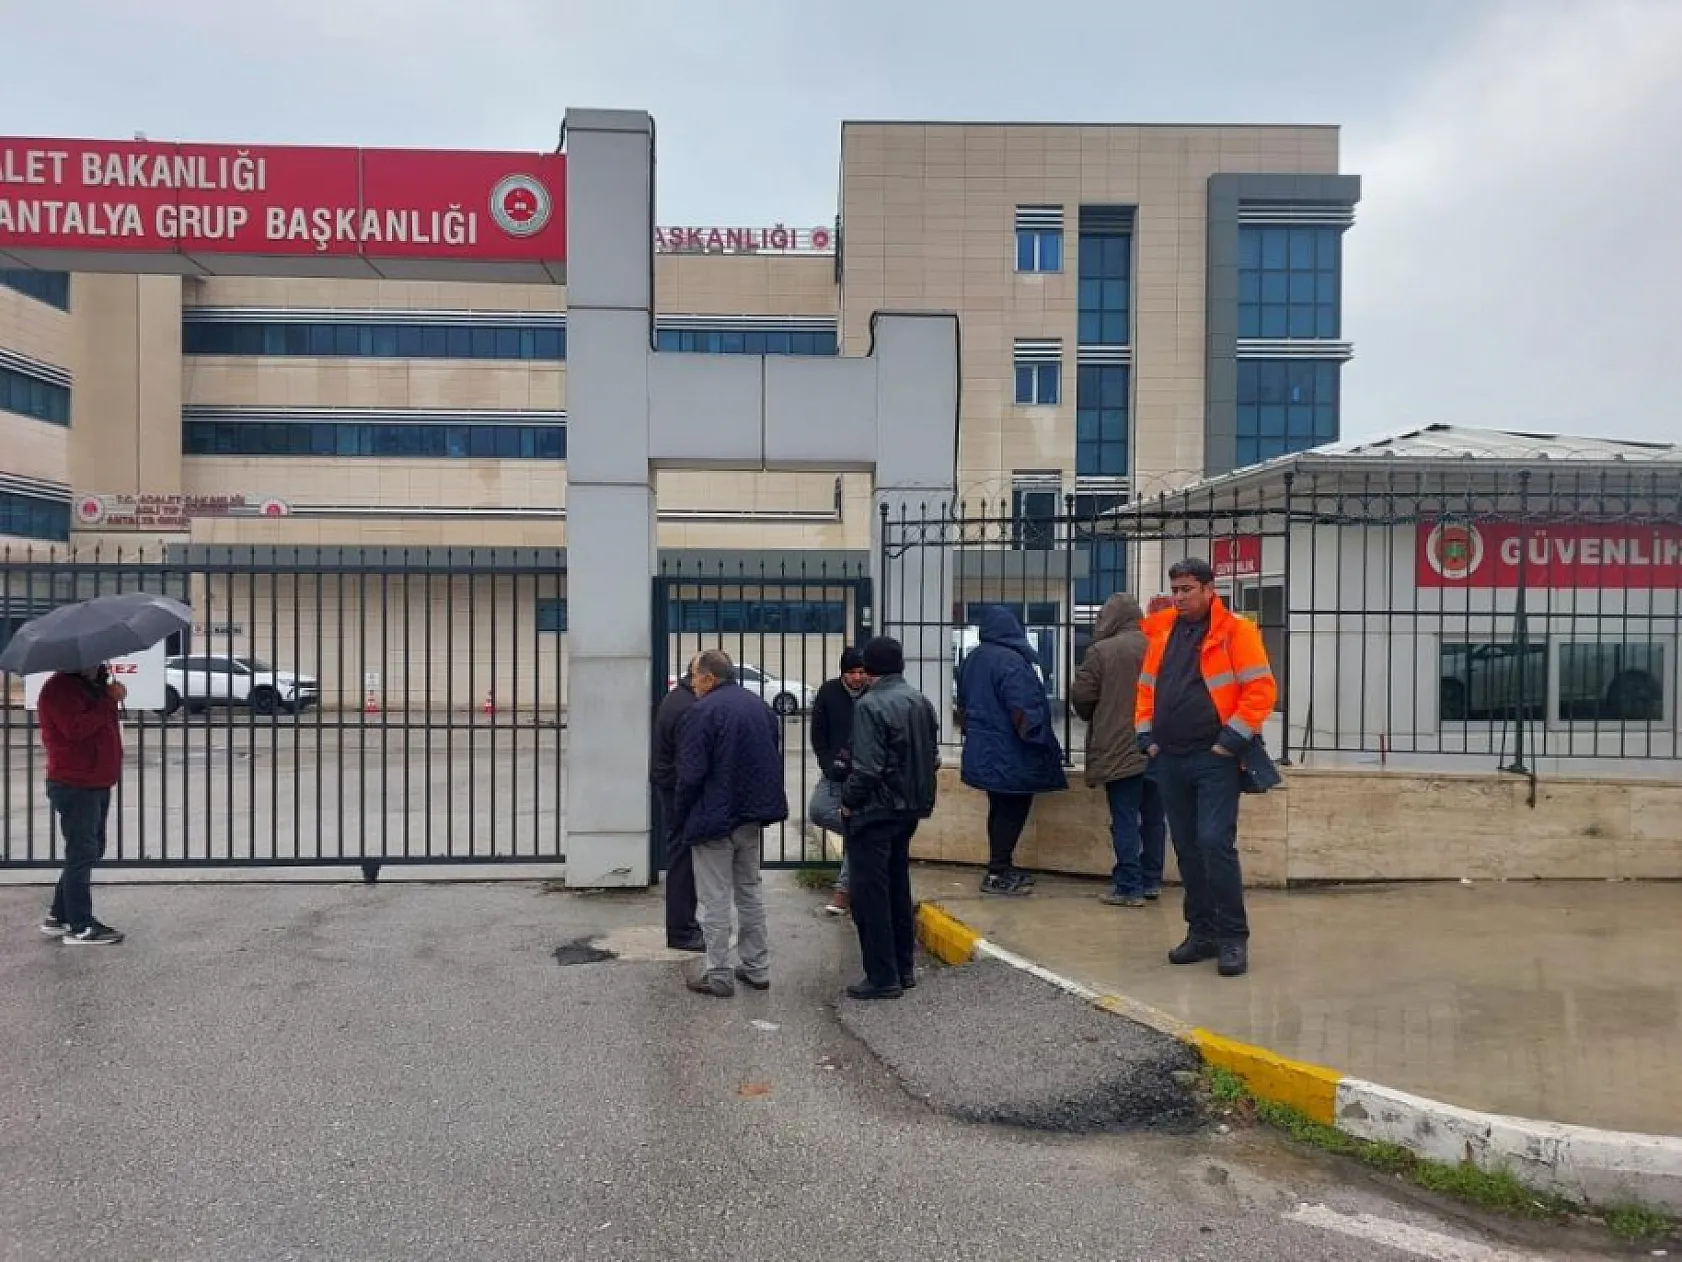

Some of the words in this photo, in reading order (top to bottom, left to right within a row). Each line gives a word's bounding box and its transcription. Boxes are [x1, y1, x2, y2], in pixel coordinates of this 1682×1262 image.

[0, 148, 69, 185] LET
[82, 149, 266, 191] BAKANLIĞI
[0, 199, 145, 236] ANTALYA
[156, 204, 248, 239] GRUP
[265, 203, 477, 251] BAŞKANLIĞI
[1501, 530, 1682, 565] GÜVENLİK
